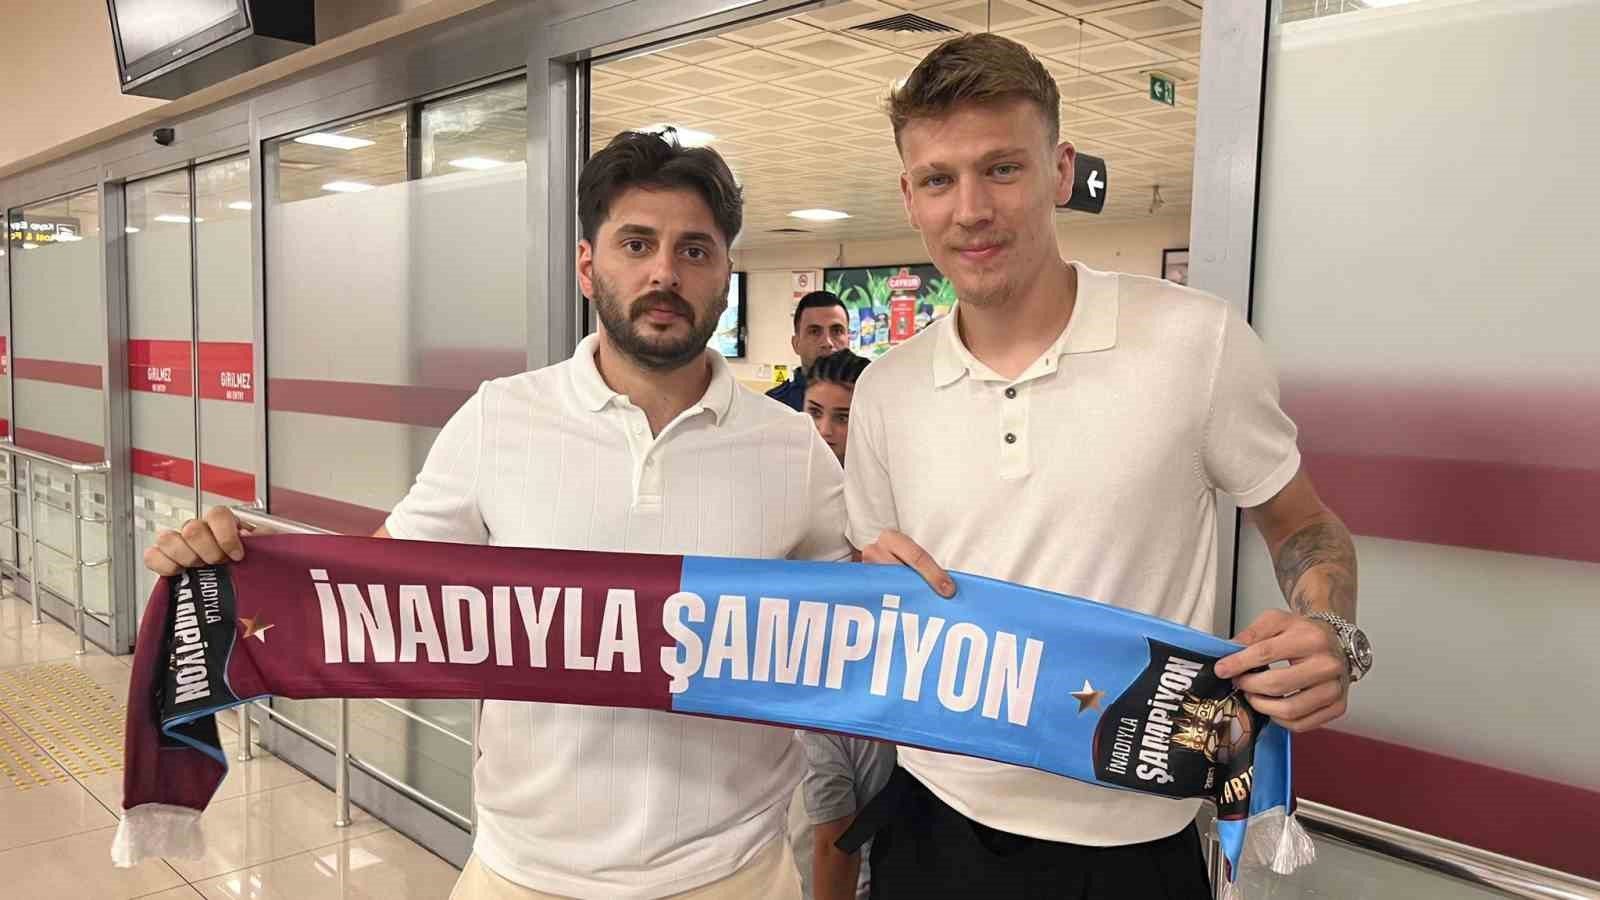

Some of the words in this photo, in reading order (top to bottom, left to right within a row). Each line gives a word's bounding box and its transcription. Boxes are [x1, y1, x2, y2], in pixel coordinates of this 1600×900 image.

[309, 568, 642, 673] İNADIYLA
[659, 591, 1045, 728] ŞAMPİYON
[1105, 717, 1138, 775] İNADIYLA
[1135, 655, 1204, 785] ŞAMPİYON
